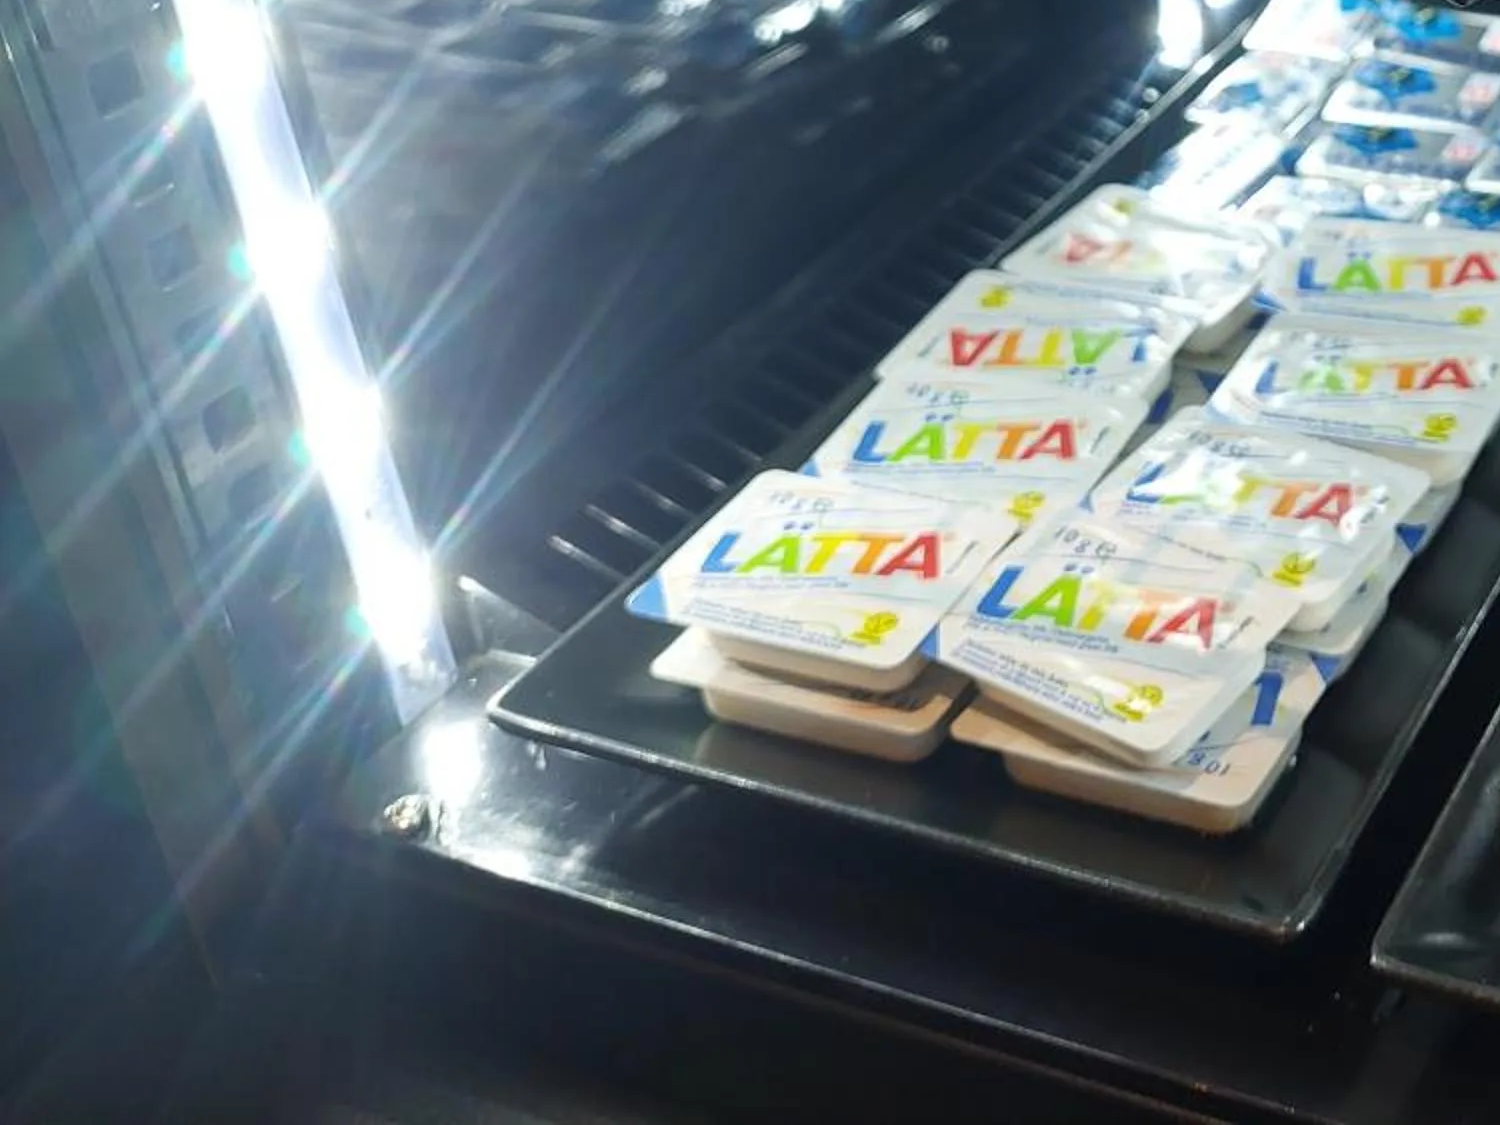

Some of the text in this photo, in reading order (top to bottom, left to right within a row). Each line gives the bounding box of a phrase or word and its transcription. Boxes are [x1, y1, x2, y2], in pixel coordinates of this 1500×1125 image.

[1296, 250, 1499, 293] LÄTTA
[1256, 355, 1474, 394] LÄTTA
[852, 412, 1078, 462] LÄTTA
[700, 521, 943, 580] LÄTTA
[976, 562, 1220, 651] LÄTTA
